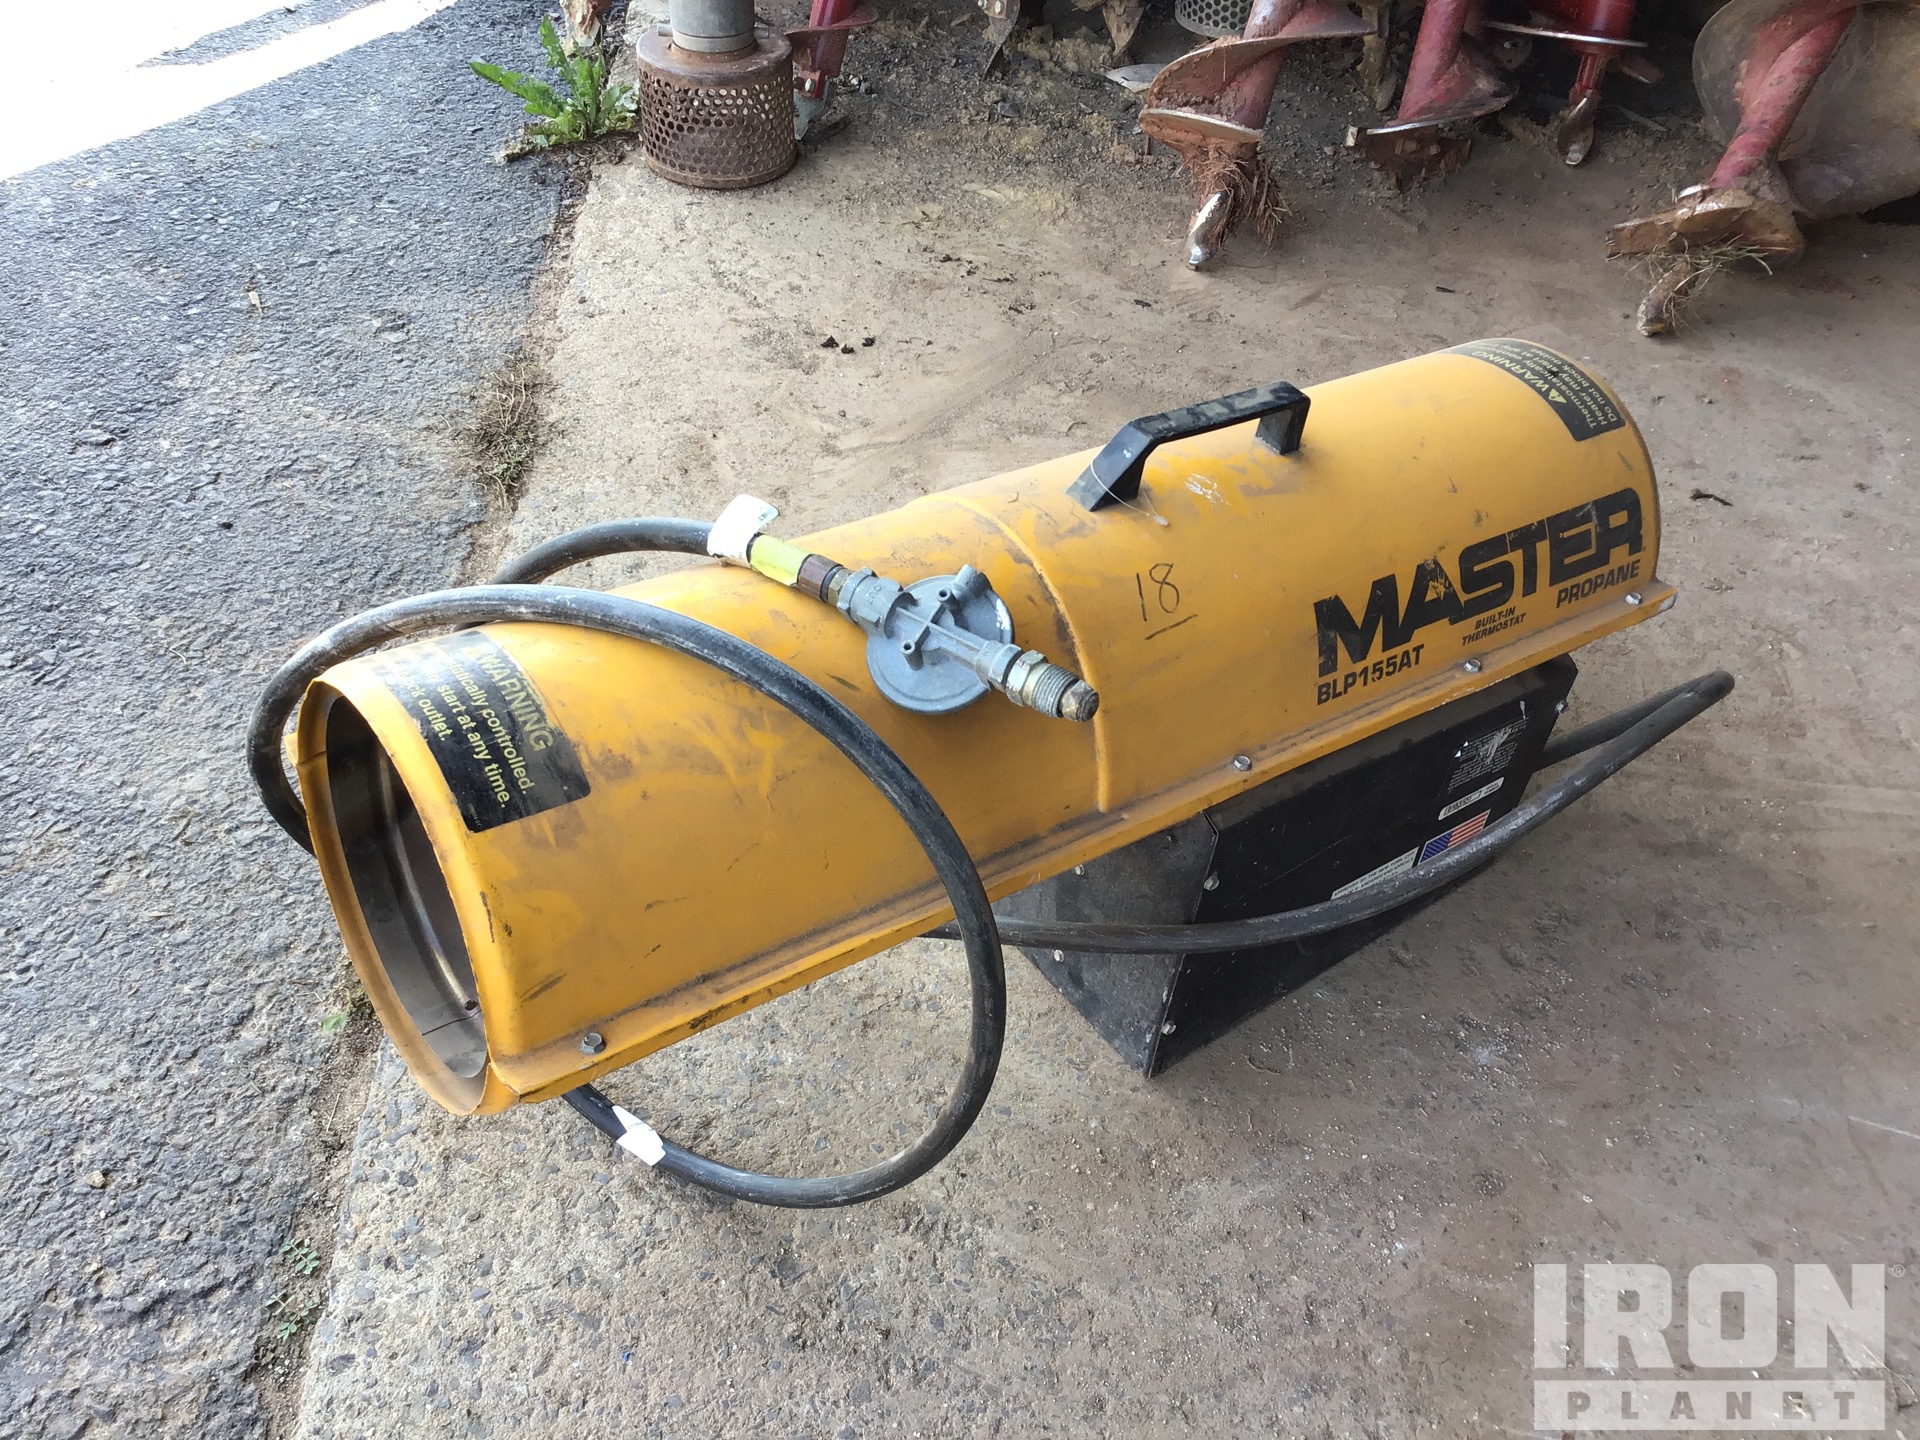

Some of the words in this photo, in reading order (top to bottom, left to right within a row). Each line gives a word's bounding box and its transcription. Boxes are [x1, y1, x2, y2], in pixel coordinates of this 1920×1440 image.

[1471, 350, 1549, 392] WARNING
[1532, 357, 1560, 372] start
[1559, 373, 1581, 391] may
[1562, 364, 1590, 387] block
[1523, 360, 1597, 429] Thermostatically
[1579, 391, 1607, 426] Heater
[1588, 387, 1606, 405] not
[1604, 406, 1618, 422] Do
[1136, 563, 1180, 622] 18
[1314, 487, 1644, 678] MASTER
[1556, 558, 1642, 608] PROPANE
[1462, 612, 1527, 646] THERMOSTAT
[1474, 605, 1516, 630] BUILT-IN
[1317, 644, 1425, 706] BLP155AT
[418, 698, 454, 741] outlet.
[478, 654, 554, 751] WARNING
[437, 684, 466, 713] start
[457, 714, 477, 731] at
[467, 732, 492, 760] any
[484, 763, 511, 809] time.
[482, 708, 536, 795] controlled.
